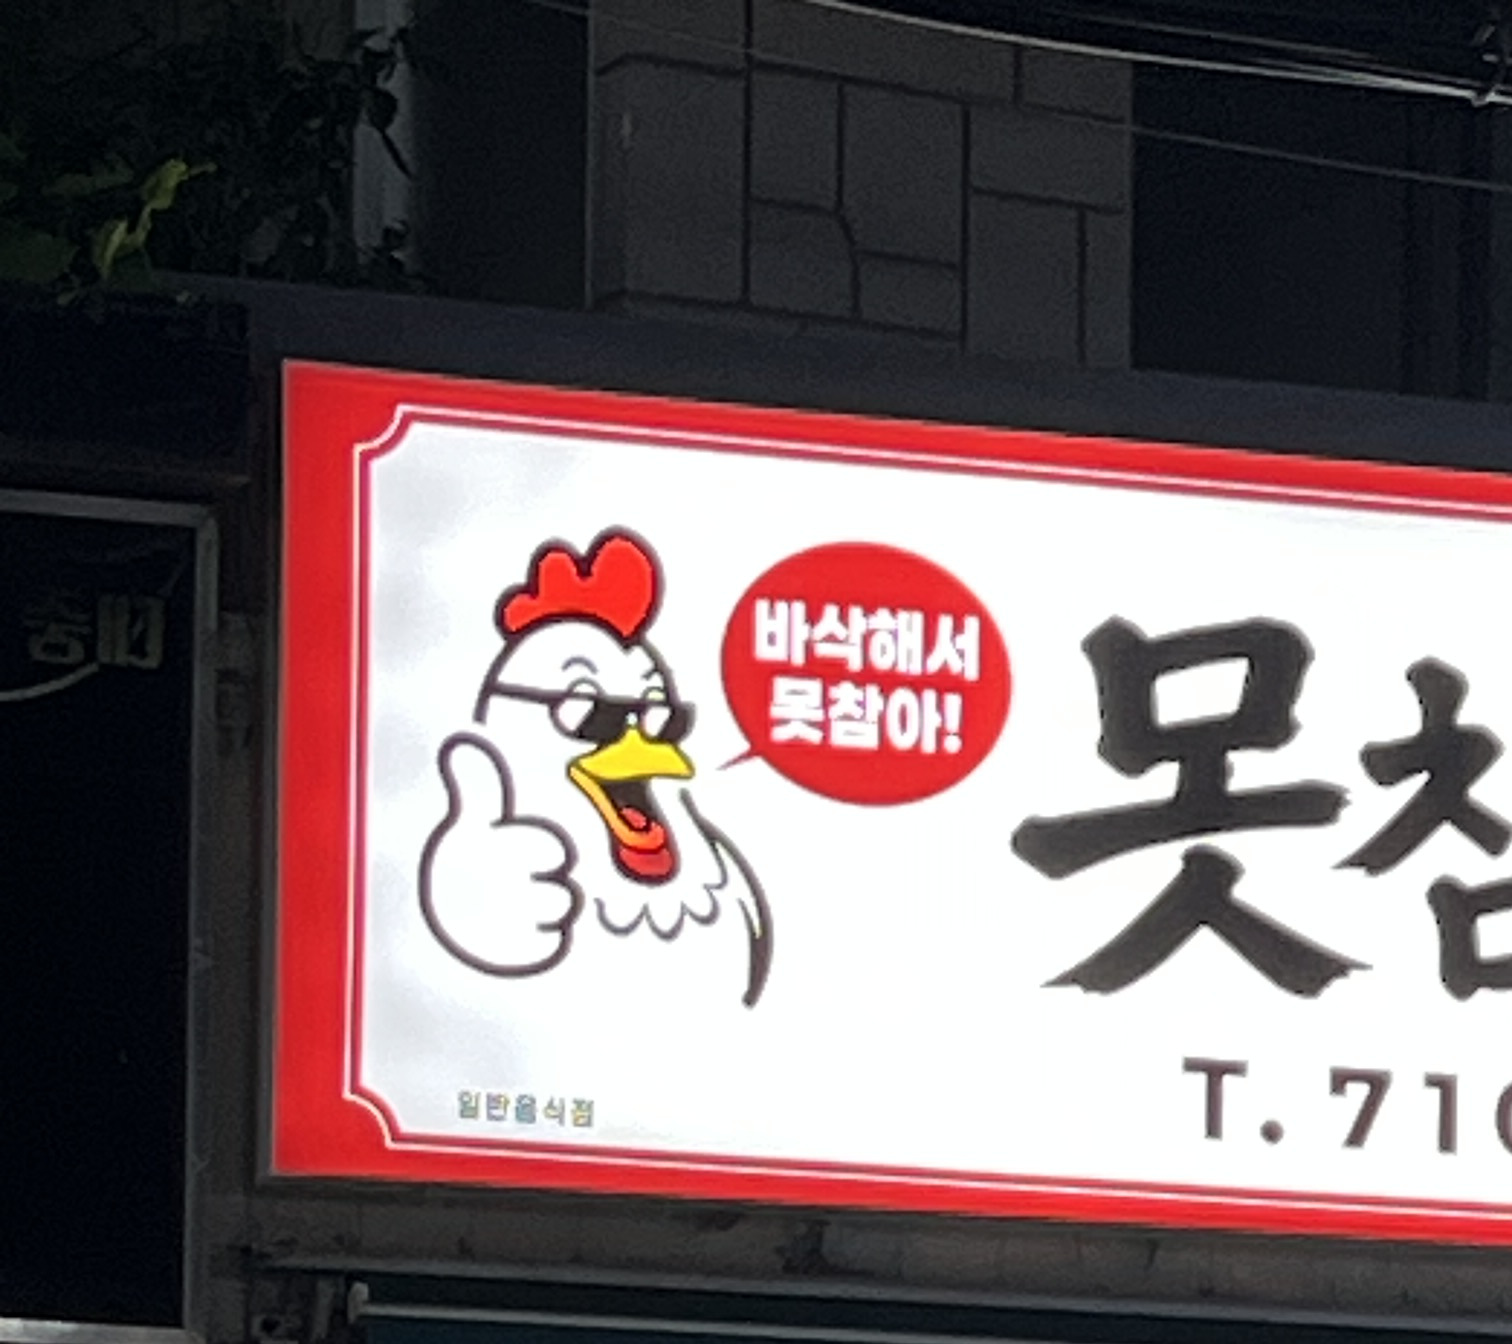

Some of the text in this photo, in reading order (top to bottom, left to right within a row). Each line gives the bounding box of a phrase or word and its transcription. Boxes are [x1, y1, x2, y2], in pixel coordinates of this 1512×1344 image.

[753, 599, 981, 682] 바삭해서
[769, 676, 962, 754] 못참아!
[457, 1090, 596, 1129] 일반음식점
